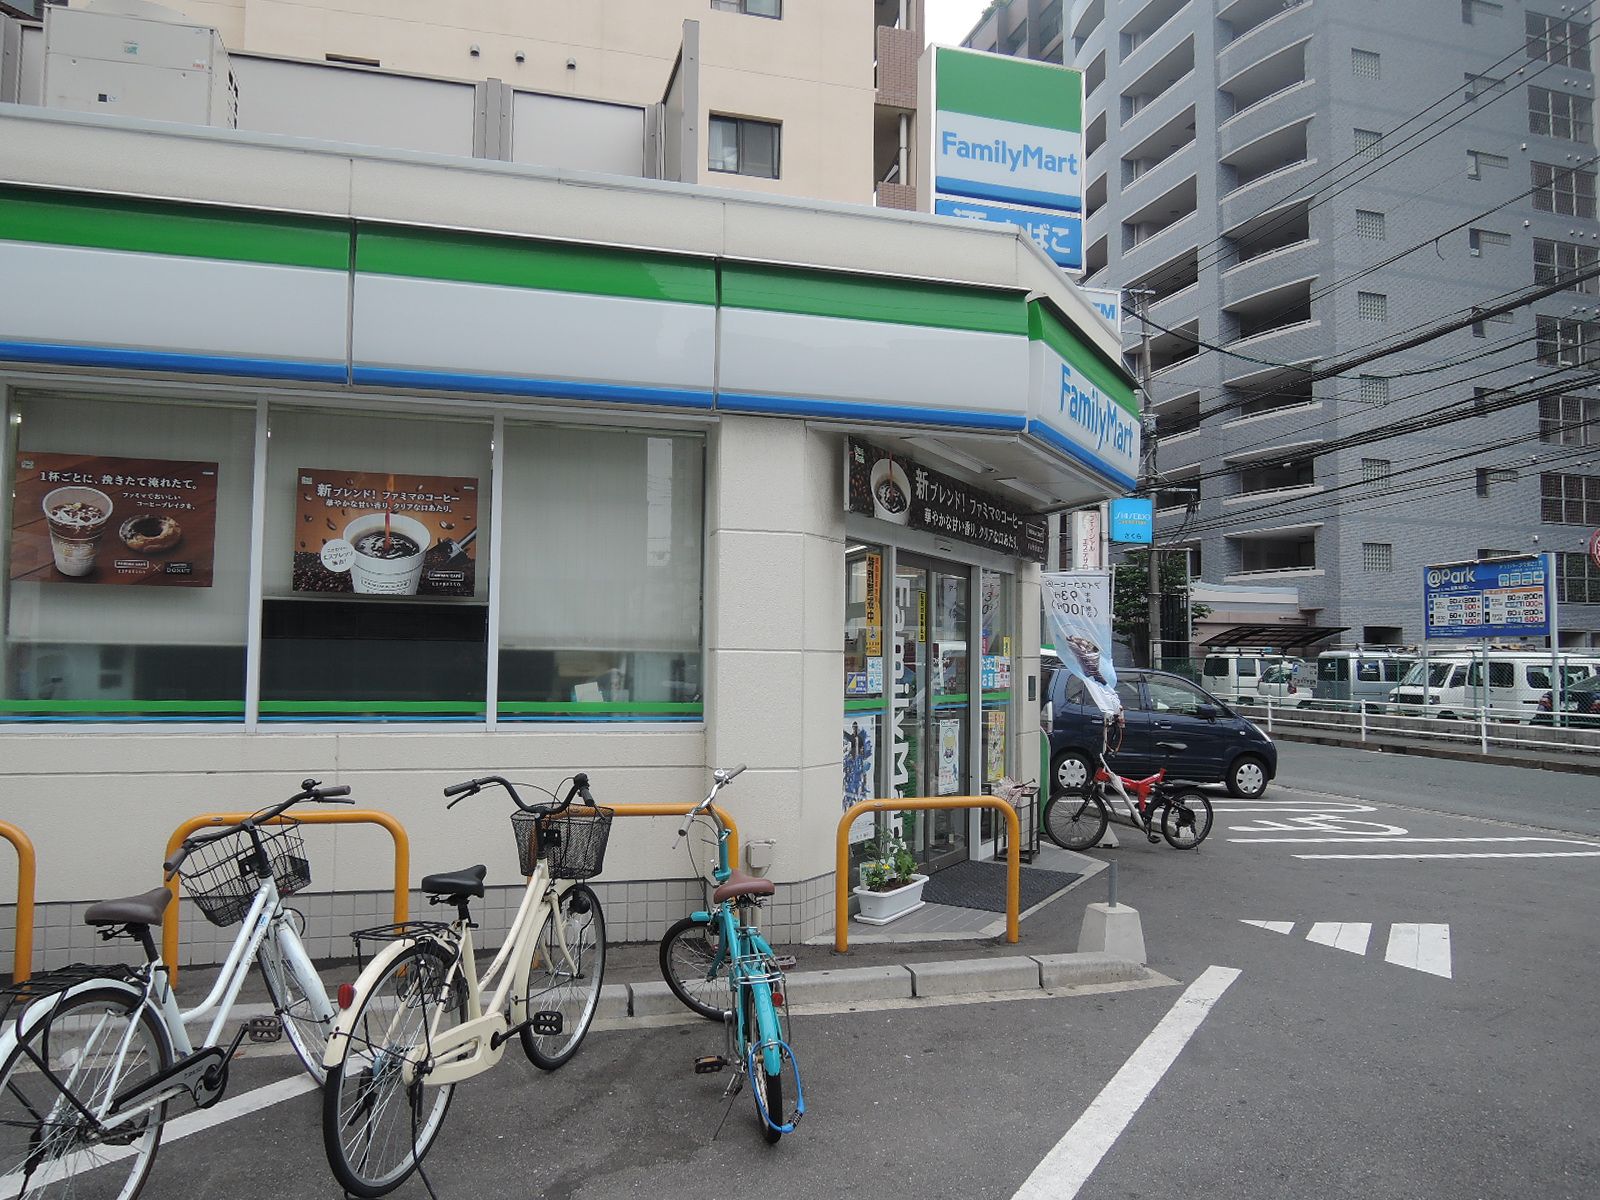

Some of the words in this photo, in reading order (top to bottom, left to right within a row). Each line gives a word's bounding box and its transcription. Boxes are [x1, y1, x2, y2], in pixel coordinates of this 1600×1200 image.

[942, 130, 1078, 176] FamilyMart
[1060, 362, 1134, 458] FamilyMart
[1427, 567, 1476, 588] @Park
